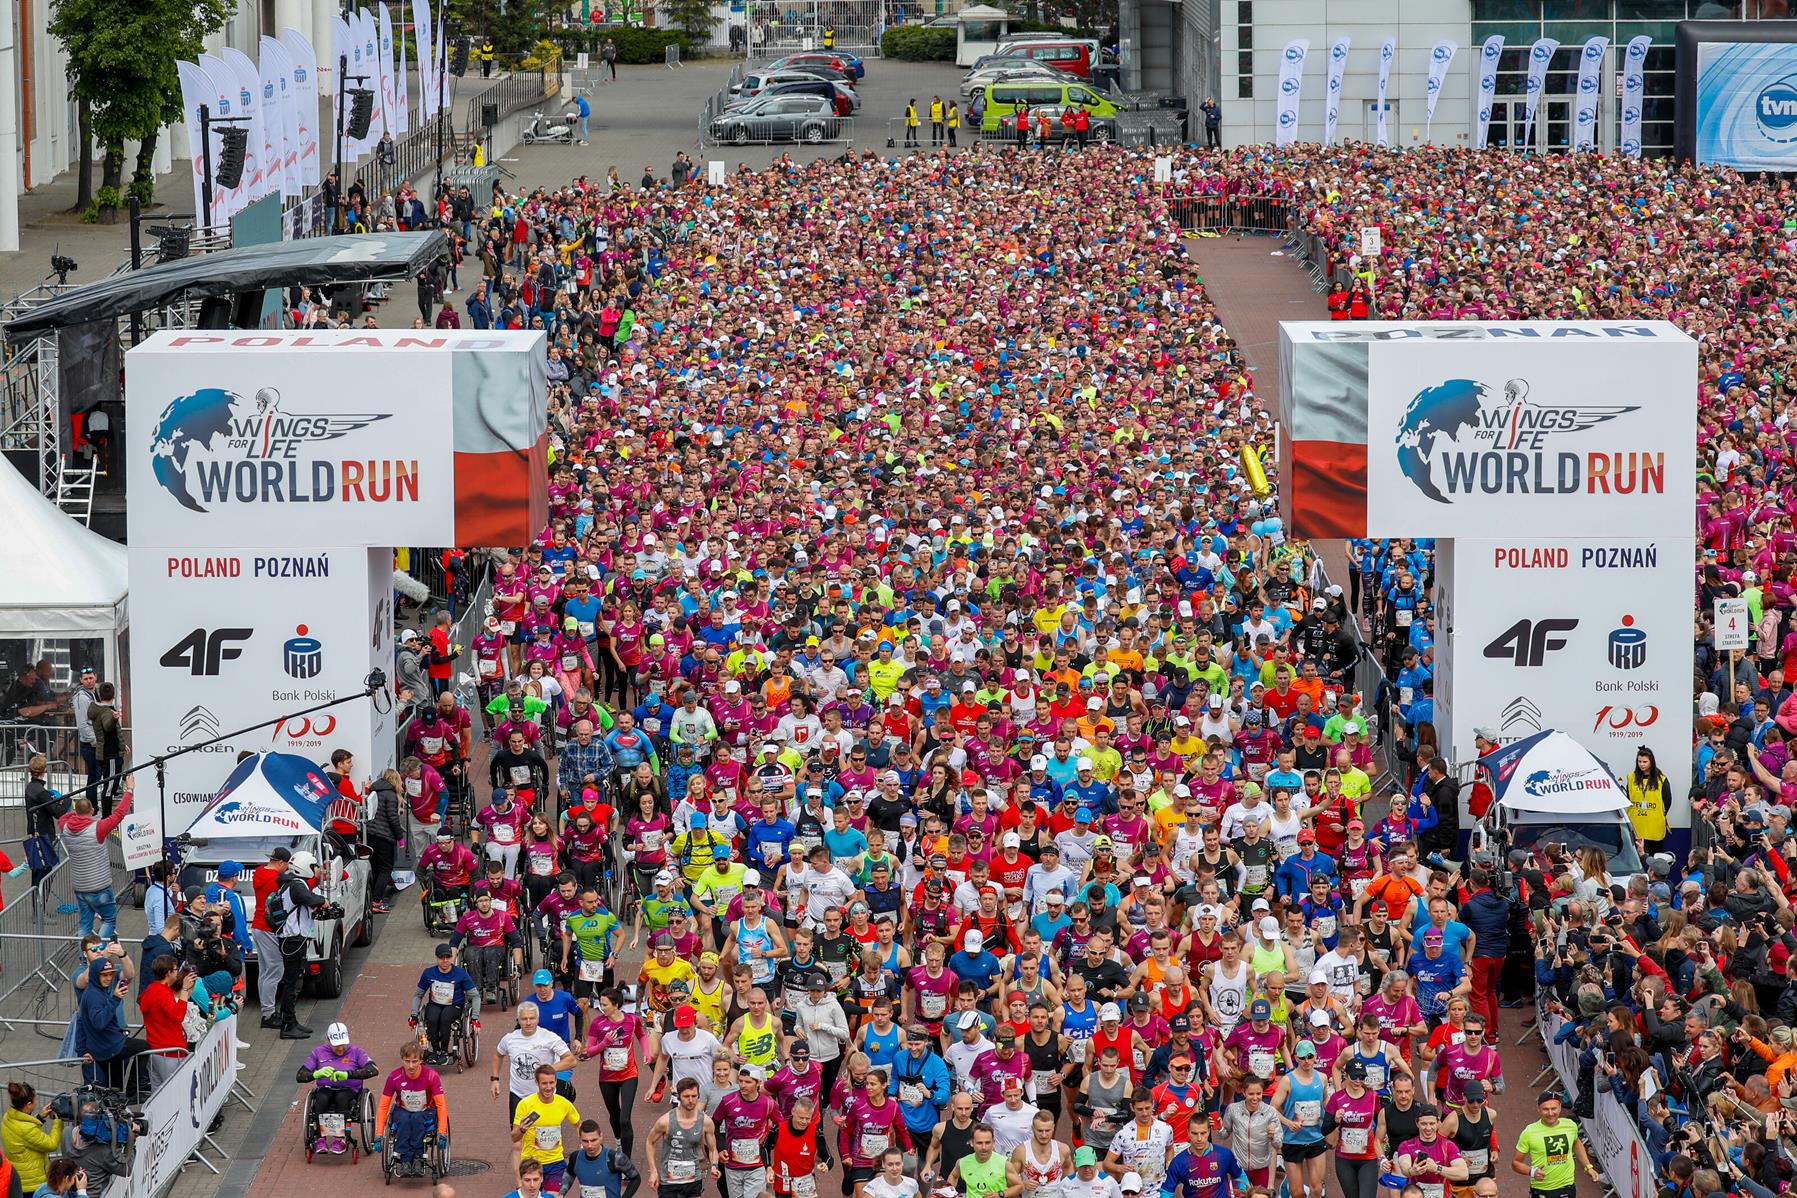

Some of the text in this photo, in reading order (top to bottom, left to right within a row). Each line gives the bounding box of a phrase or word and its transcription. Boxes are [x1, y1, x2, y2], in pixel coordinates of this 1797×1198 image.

[1761, 95, 1797, 116] tvn
[168, 336, 506, 348] POLAND
[1310, 324, 1657, 341] POZNAŃ
[233, 410, 329, 438] WINGS
[1481, 401, 1577, 429] WINGS
[228, 439, 302, 459] FOR LIFE
[1474, 430, 1549, 450] FOR LIFE
[196, 460, 419, 503] WORLD RUN
[1442, 451, 1665, 495] WORLD RUN
[168, 552, 329, 578] POLAND POZNAŃ
[1494, 542, 1657, 569] POLAND POZNAŃ
[1728, 617, 1736, 631] 4
[160, 628, 254, 676] 4F
[1482, 618, 1580, 667] 4F
[272, 690, 336, 701] Bank Polski
[1595, 680, 1659, 692] Bank Polski
[272, 714, 336, 743] 100
[1593, 704, 1659, 734] 100
[1540, 779, 1612, 795] WORLD RUN
[173, 791, 218, 804] CISOWIAN
[227, 813, 300, 830] WORLD RUN
[1188, 1176, 1222, 1188] Rakuten
